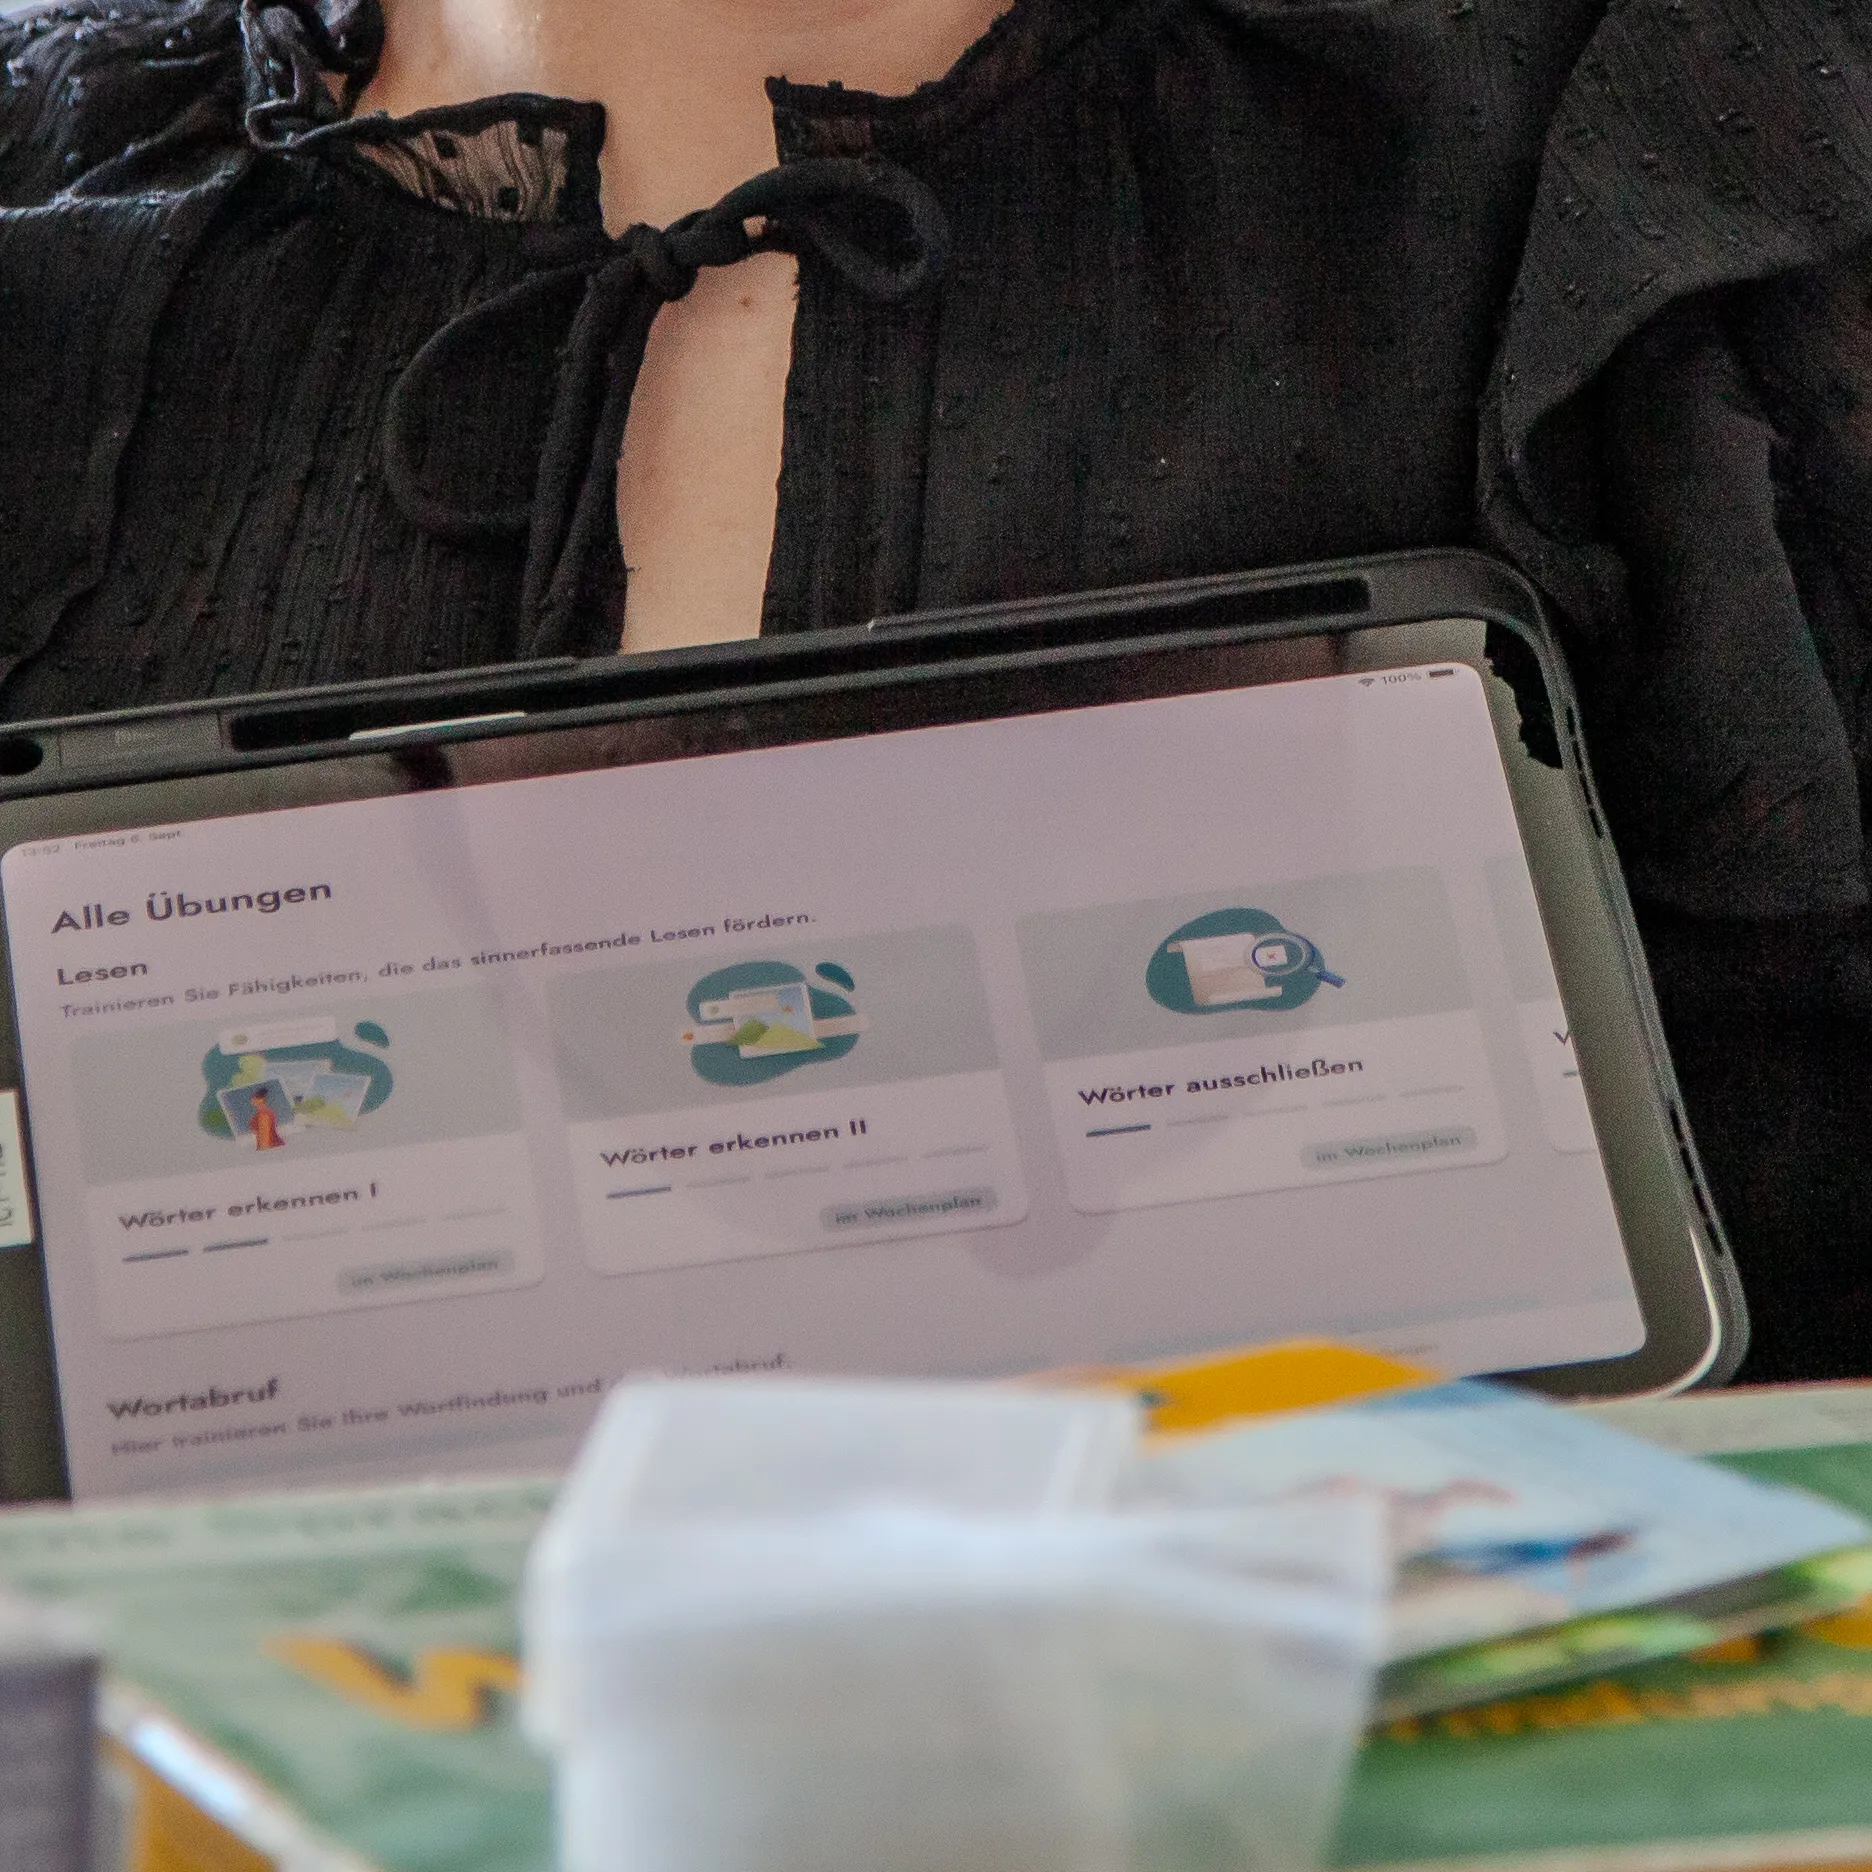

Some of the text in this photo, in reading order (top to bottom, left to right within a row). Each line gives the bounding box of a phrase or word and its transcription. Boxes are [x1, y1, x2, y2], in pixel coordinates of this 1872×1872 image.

[1380, 672, 1422, 686] 100%
[51, 881, 333, 934] Alle Übungen
[56, 960, 149, 986] Lesen
[60, 910, 817, 1018] Trainieren Sie Fähigkeiten, die das sinnerfassende Lesen fördern.
[1077, 1056, 1365, 1107] Wörter ausschließen
[599, 1117, 869, 1168] Wörter erkennen II
[1342, 1132, 1463, 1160] Wochenplan
[116, 1180, 380, 1231] Wörter erkennen I
[863, 1194, 984, 1221] Wochenplan
[107, 1376, 279, 1420] Wortabruf
[172, 1422, 288, 1448] trainieren
[295, 1415, 333, 1432] Sie
[340, 1407, 390, 1426] Ihre
[396, 1386, 550, 1418] Wortfindung
[556, 1375, 604, 1399] und
